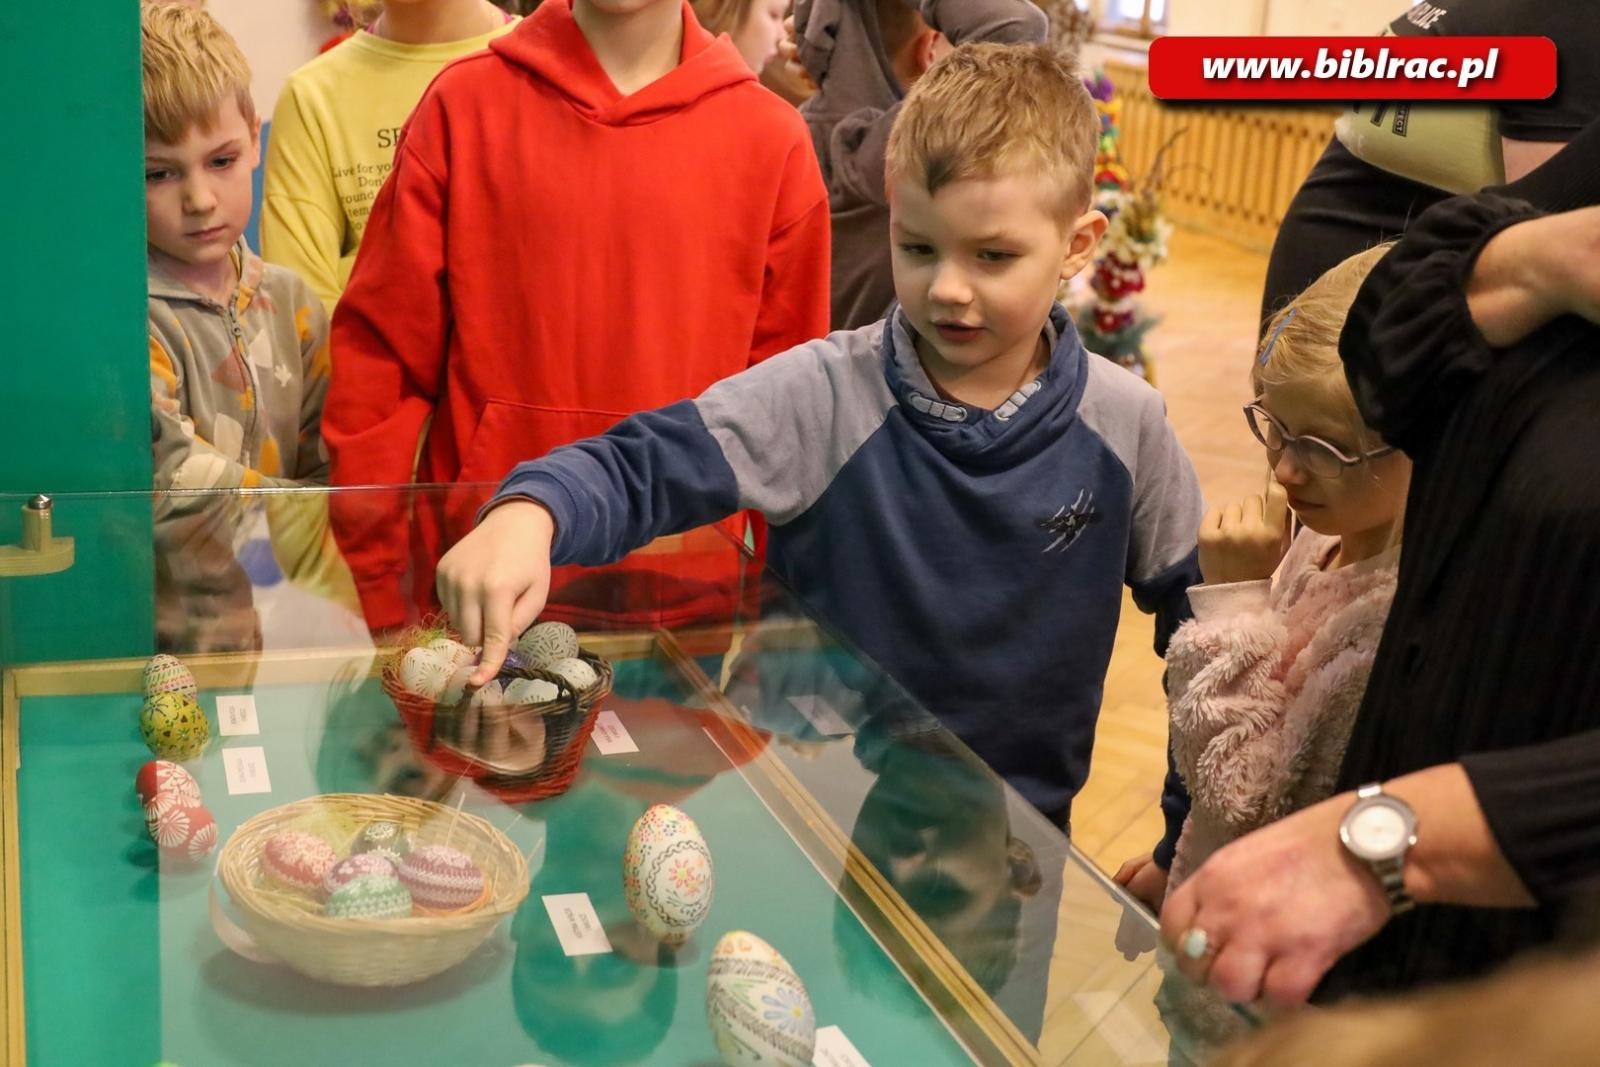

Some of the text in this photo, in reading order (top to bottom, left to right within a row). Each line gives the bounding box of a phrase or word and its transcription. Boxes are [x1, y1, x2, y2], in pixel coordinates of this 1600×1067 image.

[357, 163, 373, 174] for
[377, 162, 391, 174] yo
[358, 175, 385, 188] Don'
[341, 190, 374, 204] round
